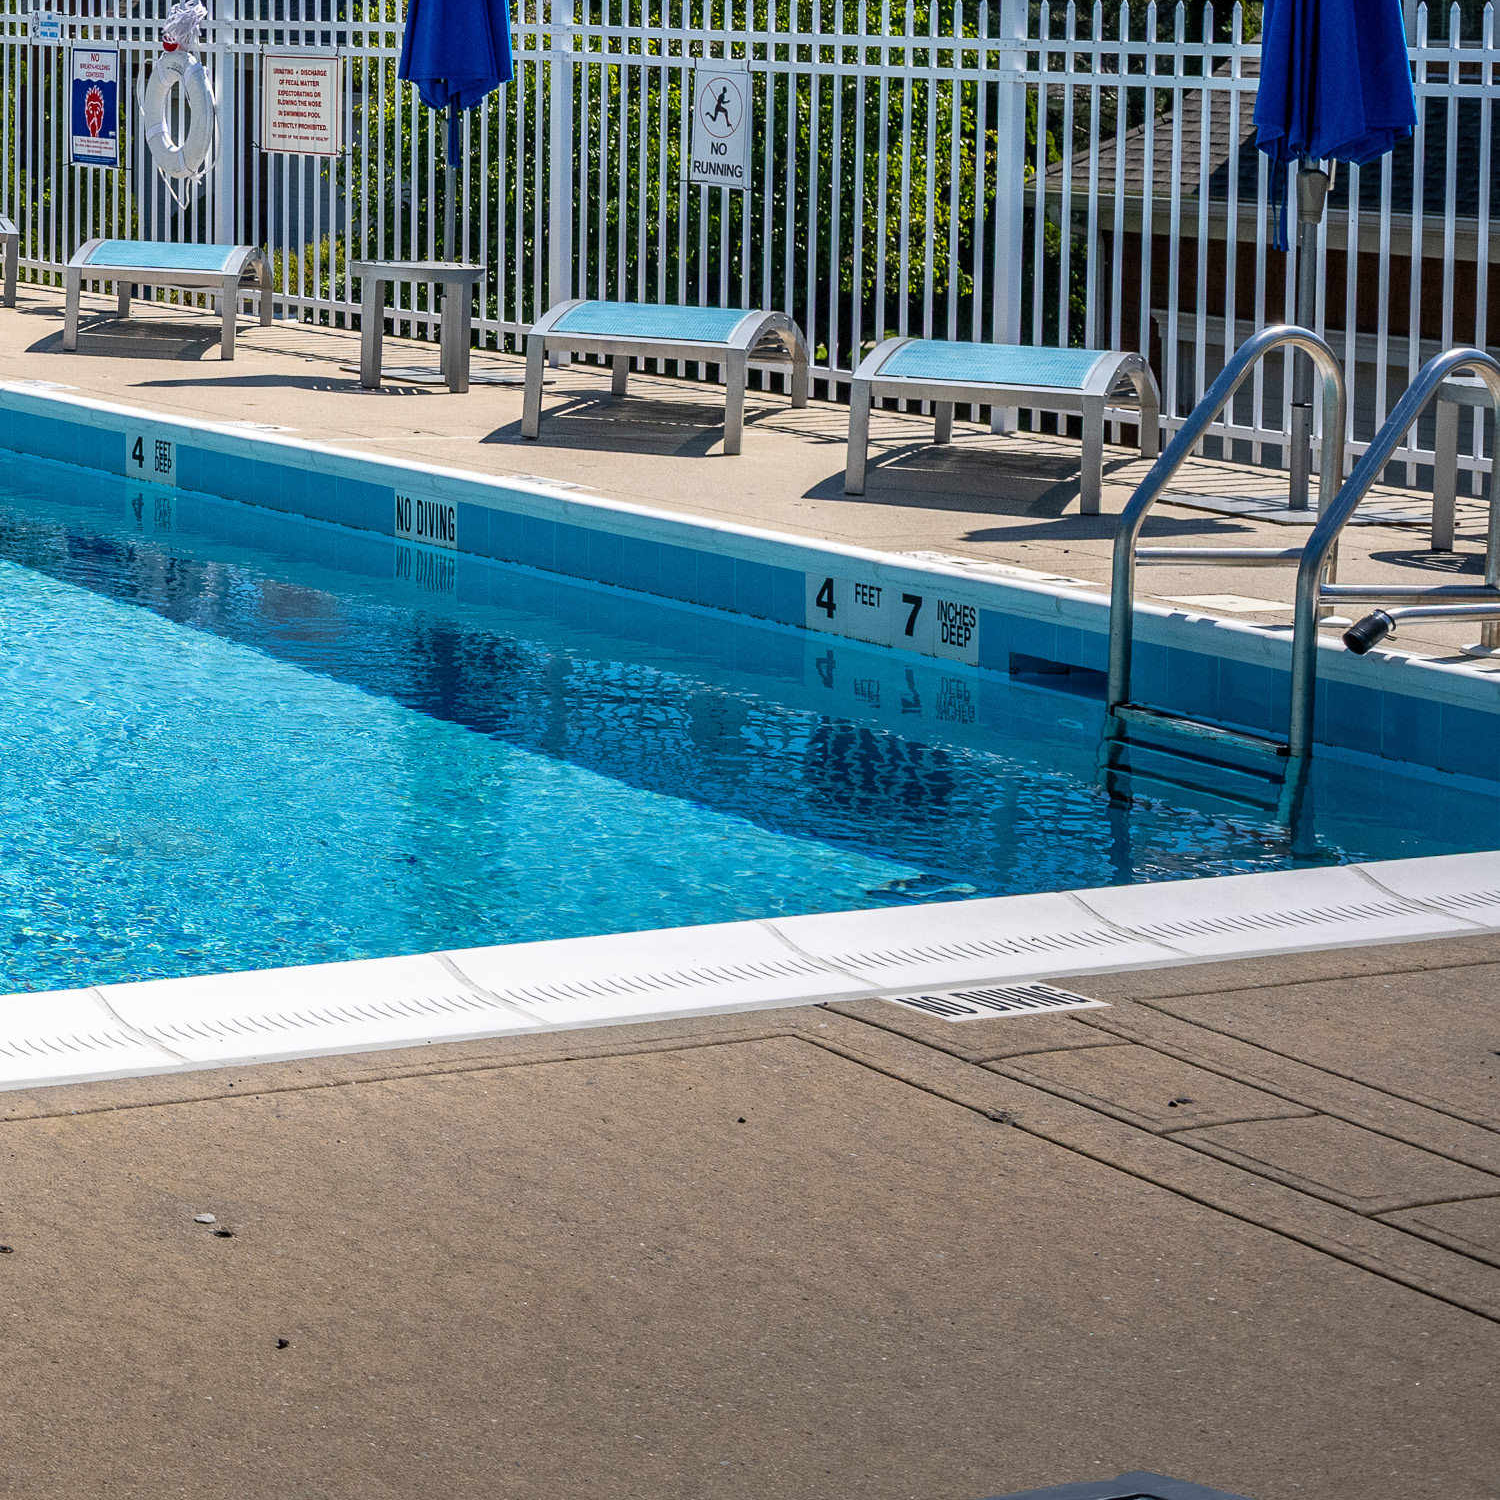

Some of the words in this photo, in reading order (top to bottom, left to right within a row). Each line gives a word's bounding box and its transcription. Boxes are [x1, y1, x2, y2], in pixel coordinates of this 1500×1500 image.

[91, 53, 100, 62] NO
[711, 142, 727, 155] NO
[693, 160, 743, 178] RUNNING
[132, 436, 144, 468] 4
[155, 440, 171, 458] FEET
[155, 456, 172, 474] DEEP
[397, 495, 411, 532] NO
[417, 499, 454, 542] DIVING
[816, 577, 836, 619] 4
[855, 582, 882, 608] FEET
[902, 592, 923, 637] 7
[937, 599, 976, 628] INCHES
[941, 622, 971, 648] DEEP
[895, 995, 978, 1017] NO
[949, 985, 1092, 1011] DIVING
